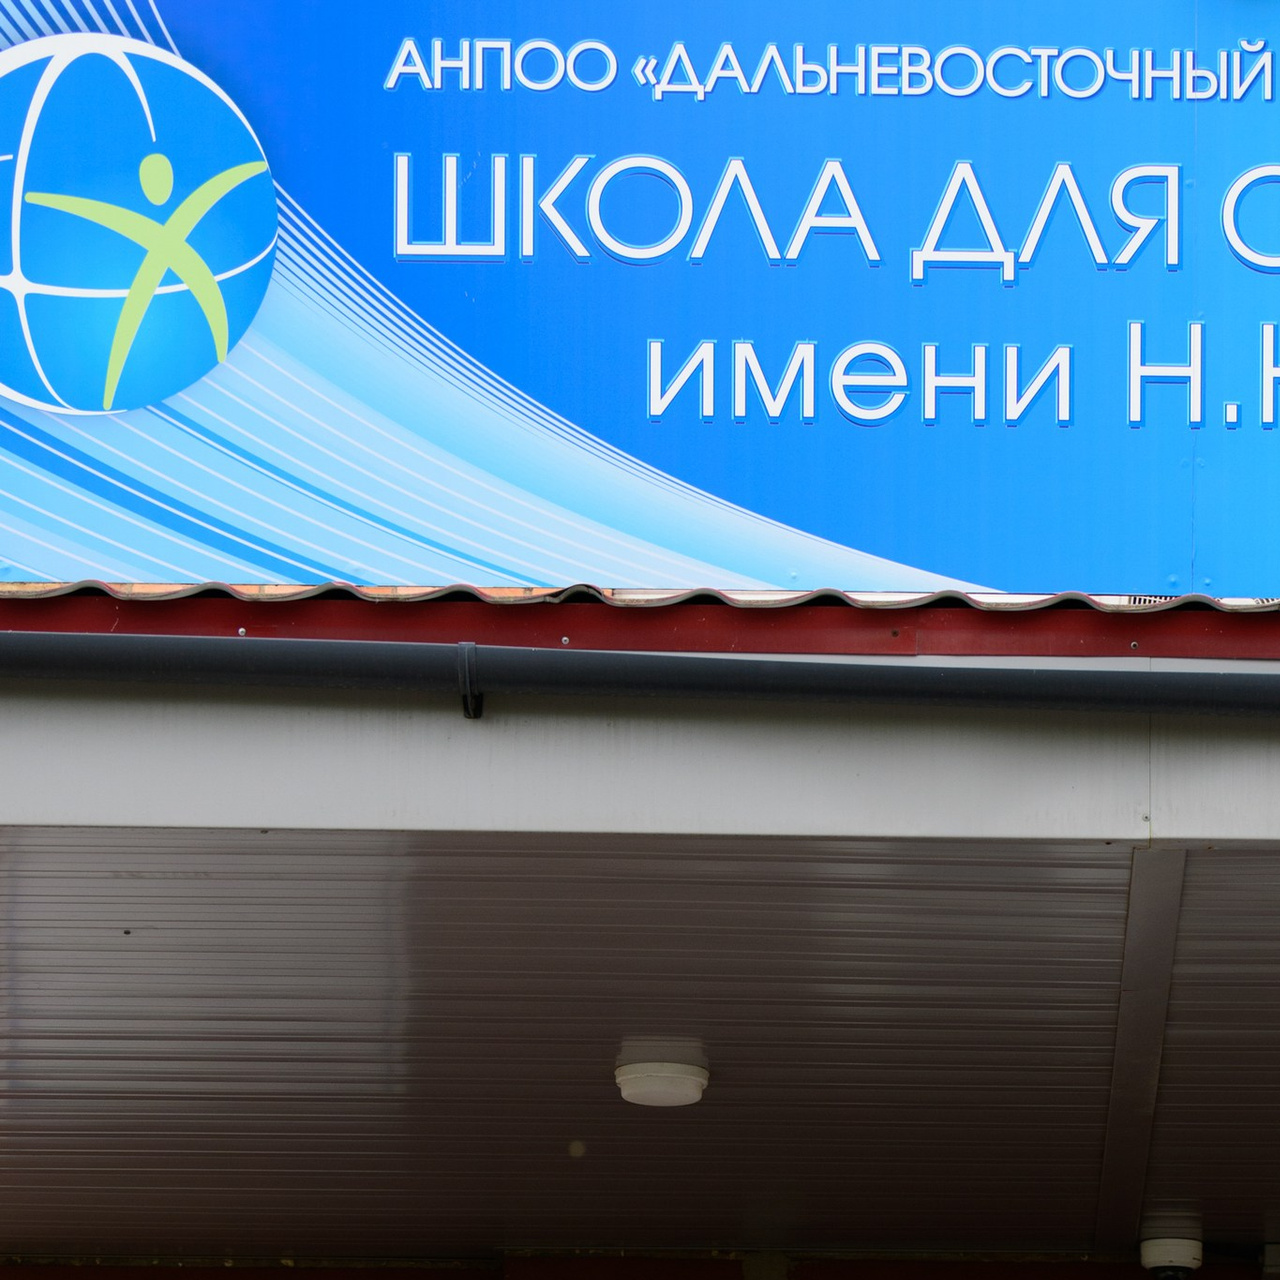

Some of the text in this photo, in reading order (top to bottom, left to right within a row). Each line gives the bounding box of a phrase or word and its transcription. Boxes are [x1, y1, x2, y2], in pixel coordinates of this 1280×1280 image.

[386, 39, 618, 92] АНПОО
[633, 39, 1274, 102] «ДАЛЬНЕВОСТОЧНЫЙ
[395, 154, 882, 264] ШКОЛА
[911, 161, 1181, 284] ДЛЯ
[648, 340, 1072, 424] имени
